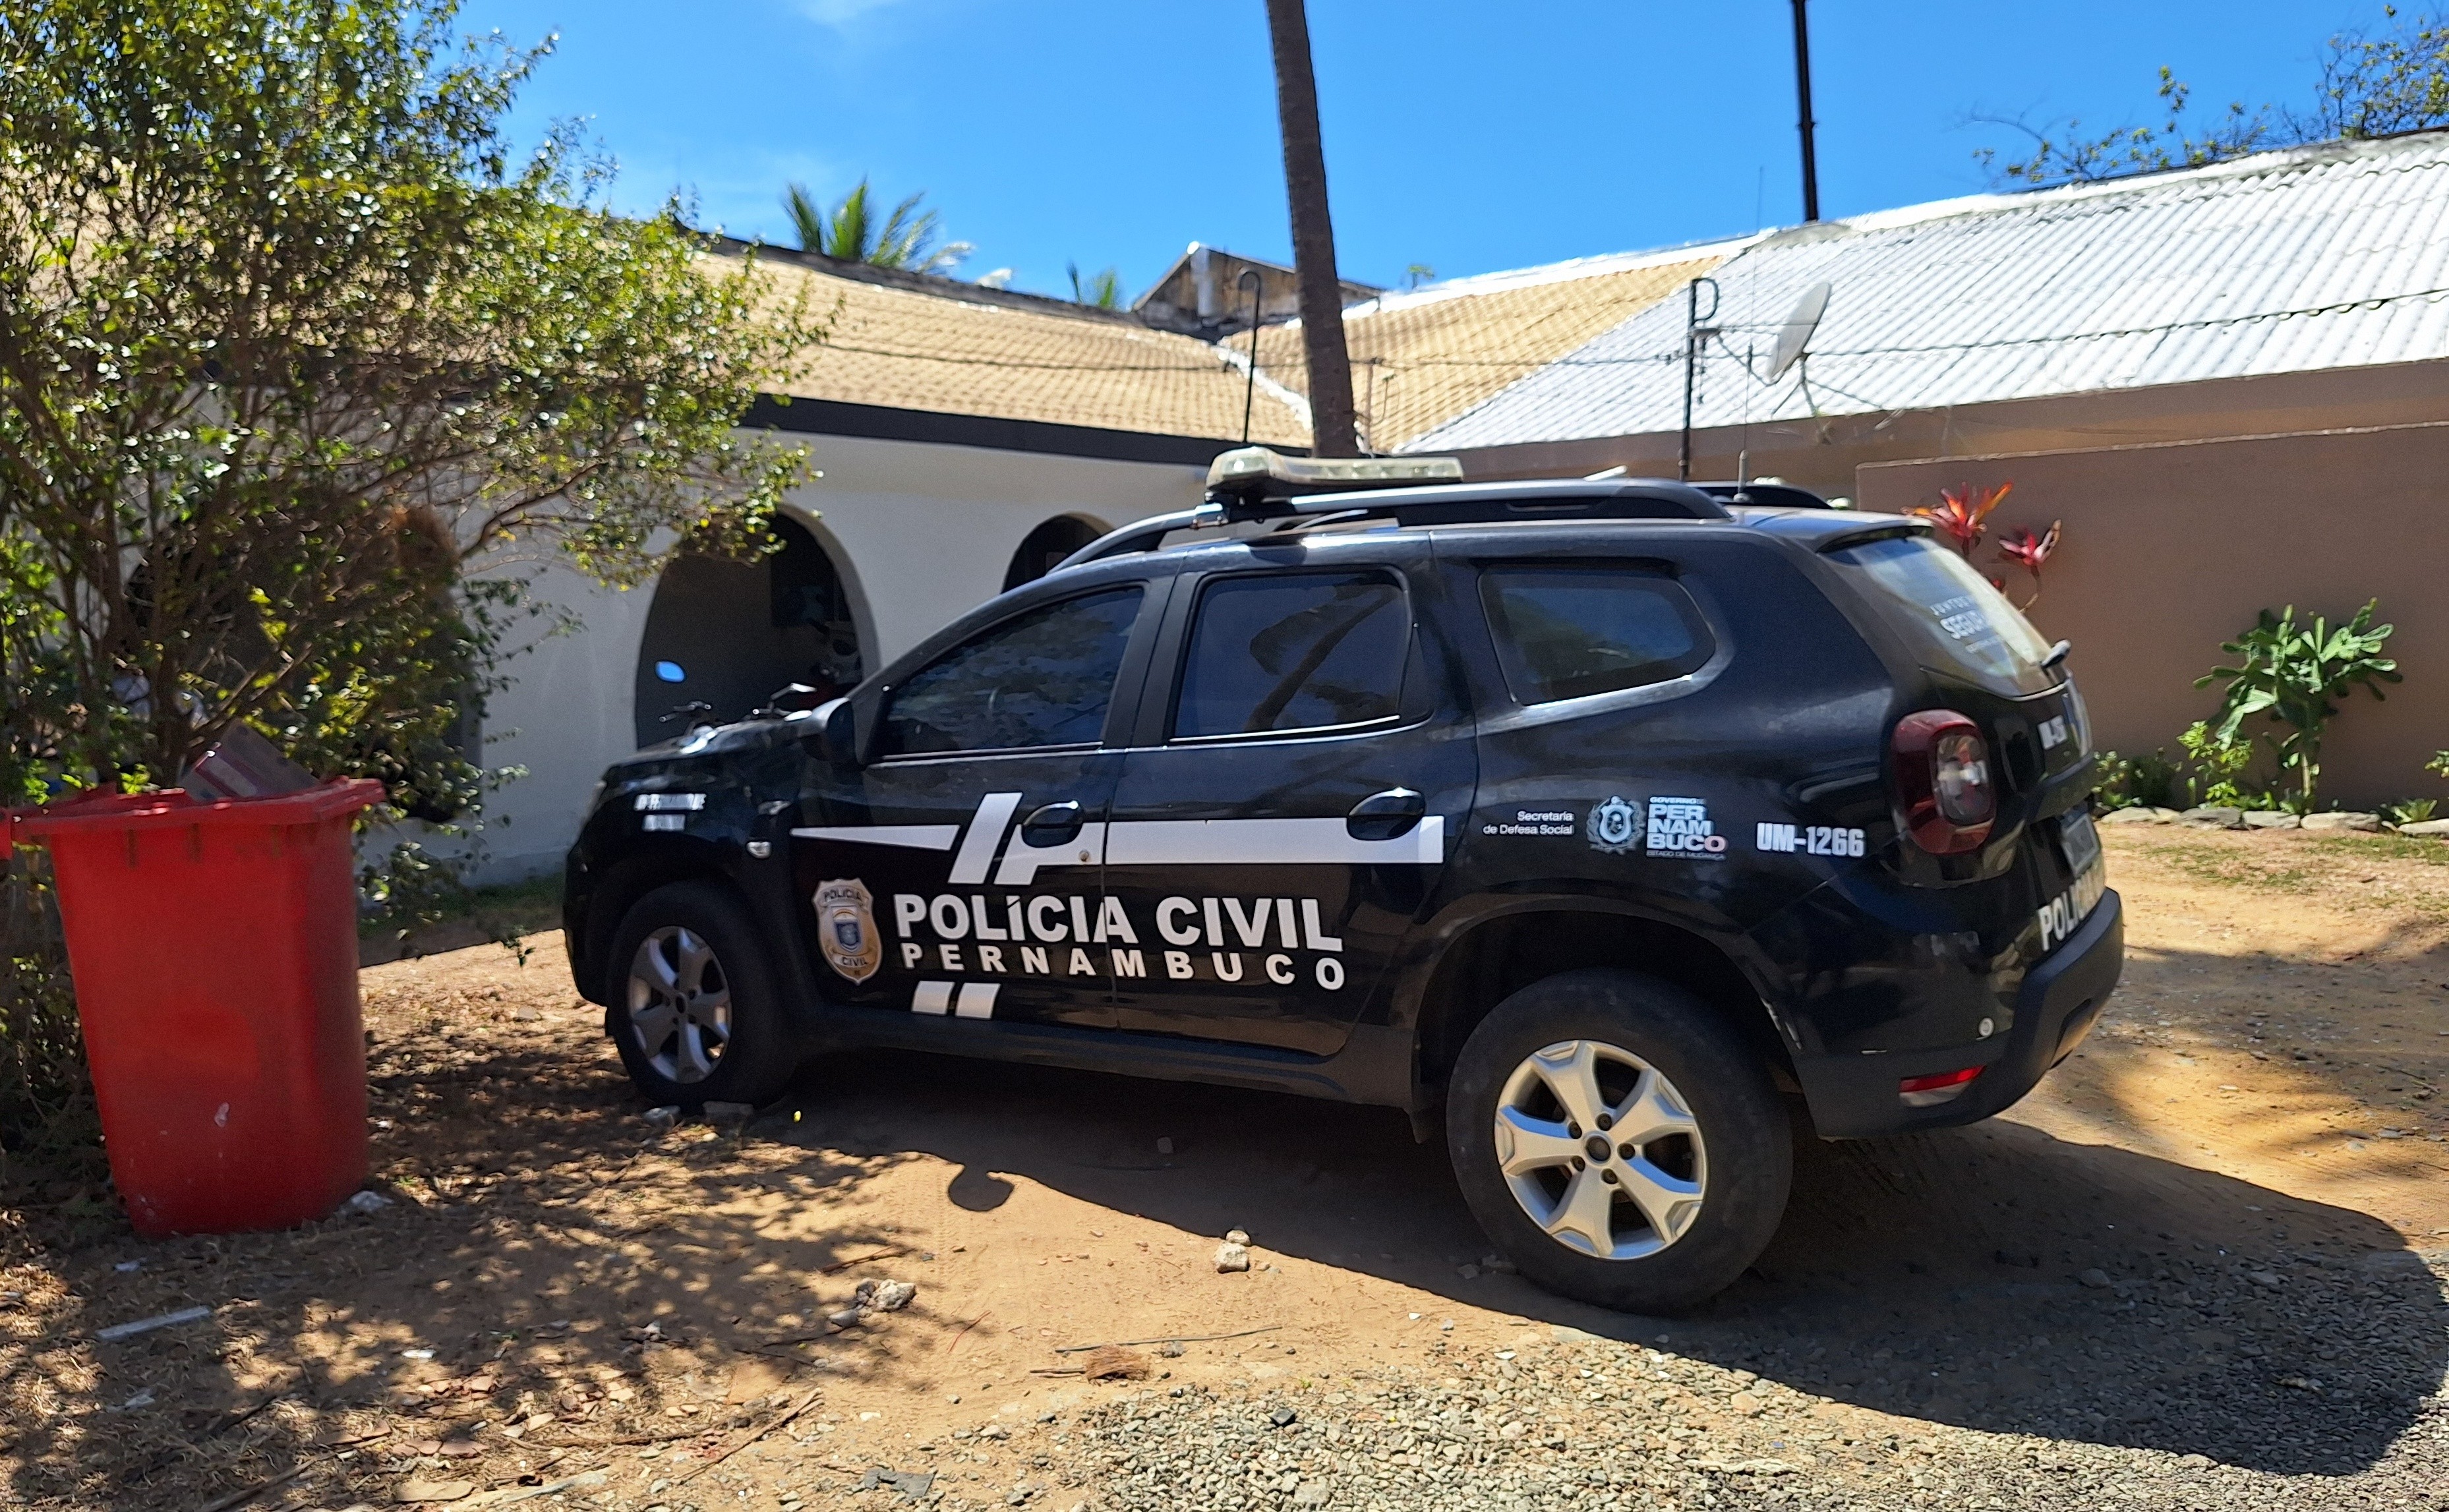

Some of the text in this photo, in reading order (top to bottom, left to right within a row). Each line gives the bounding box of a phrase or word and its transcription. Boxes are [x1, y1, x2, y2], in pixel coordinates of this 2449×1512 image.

[1518, 811, 1574, 822] Secretaria
[1649, 803, 1707, 820] PER
[1483, 825, 1574, 835] de Defesa Social
[1647, 818, 1713, 836] NAM
[1647, 832, 1727, 852] BUCO
[1757, 823, 1866, 857] UM-1266
[893, 894, 1343, 952] POLÍCIA CIVIL
[900, 943, 1345, 990] PERNAMBUCO
